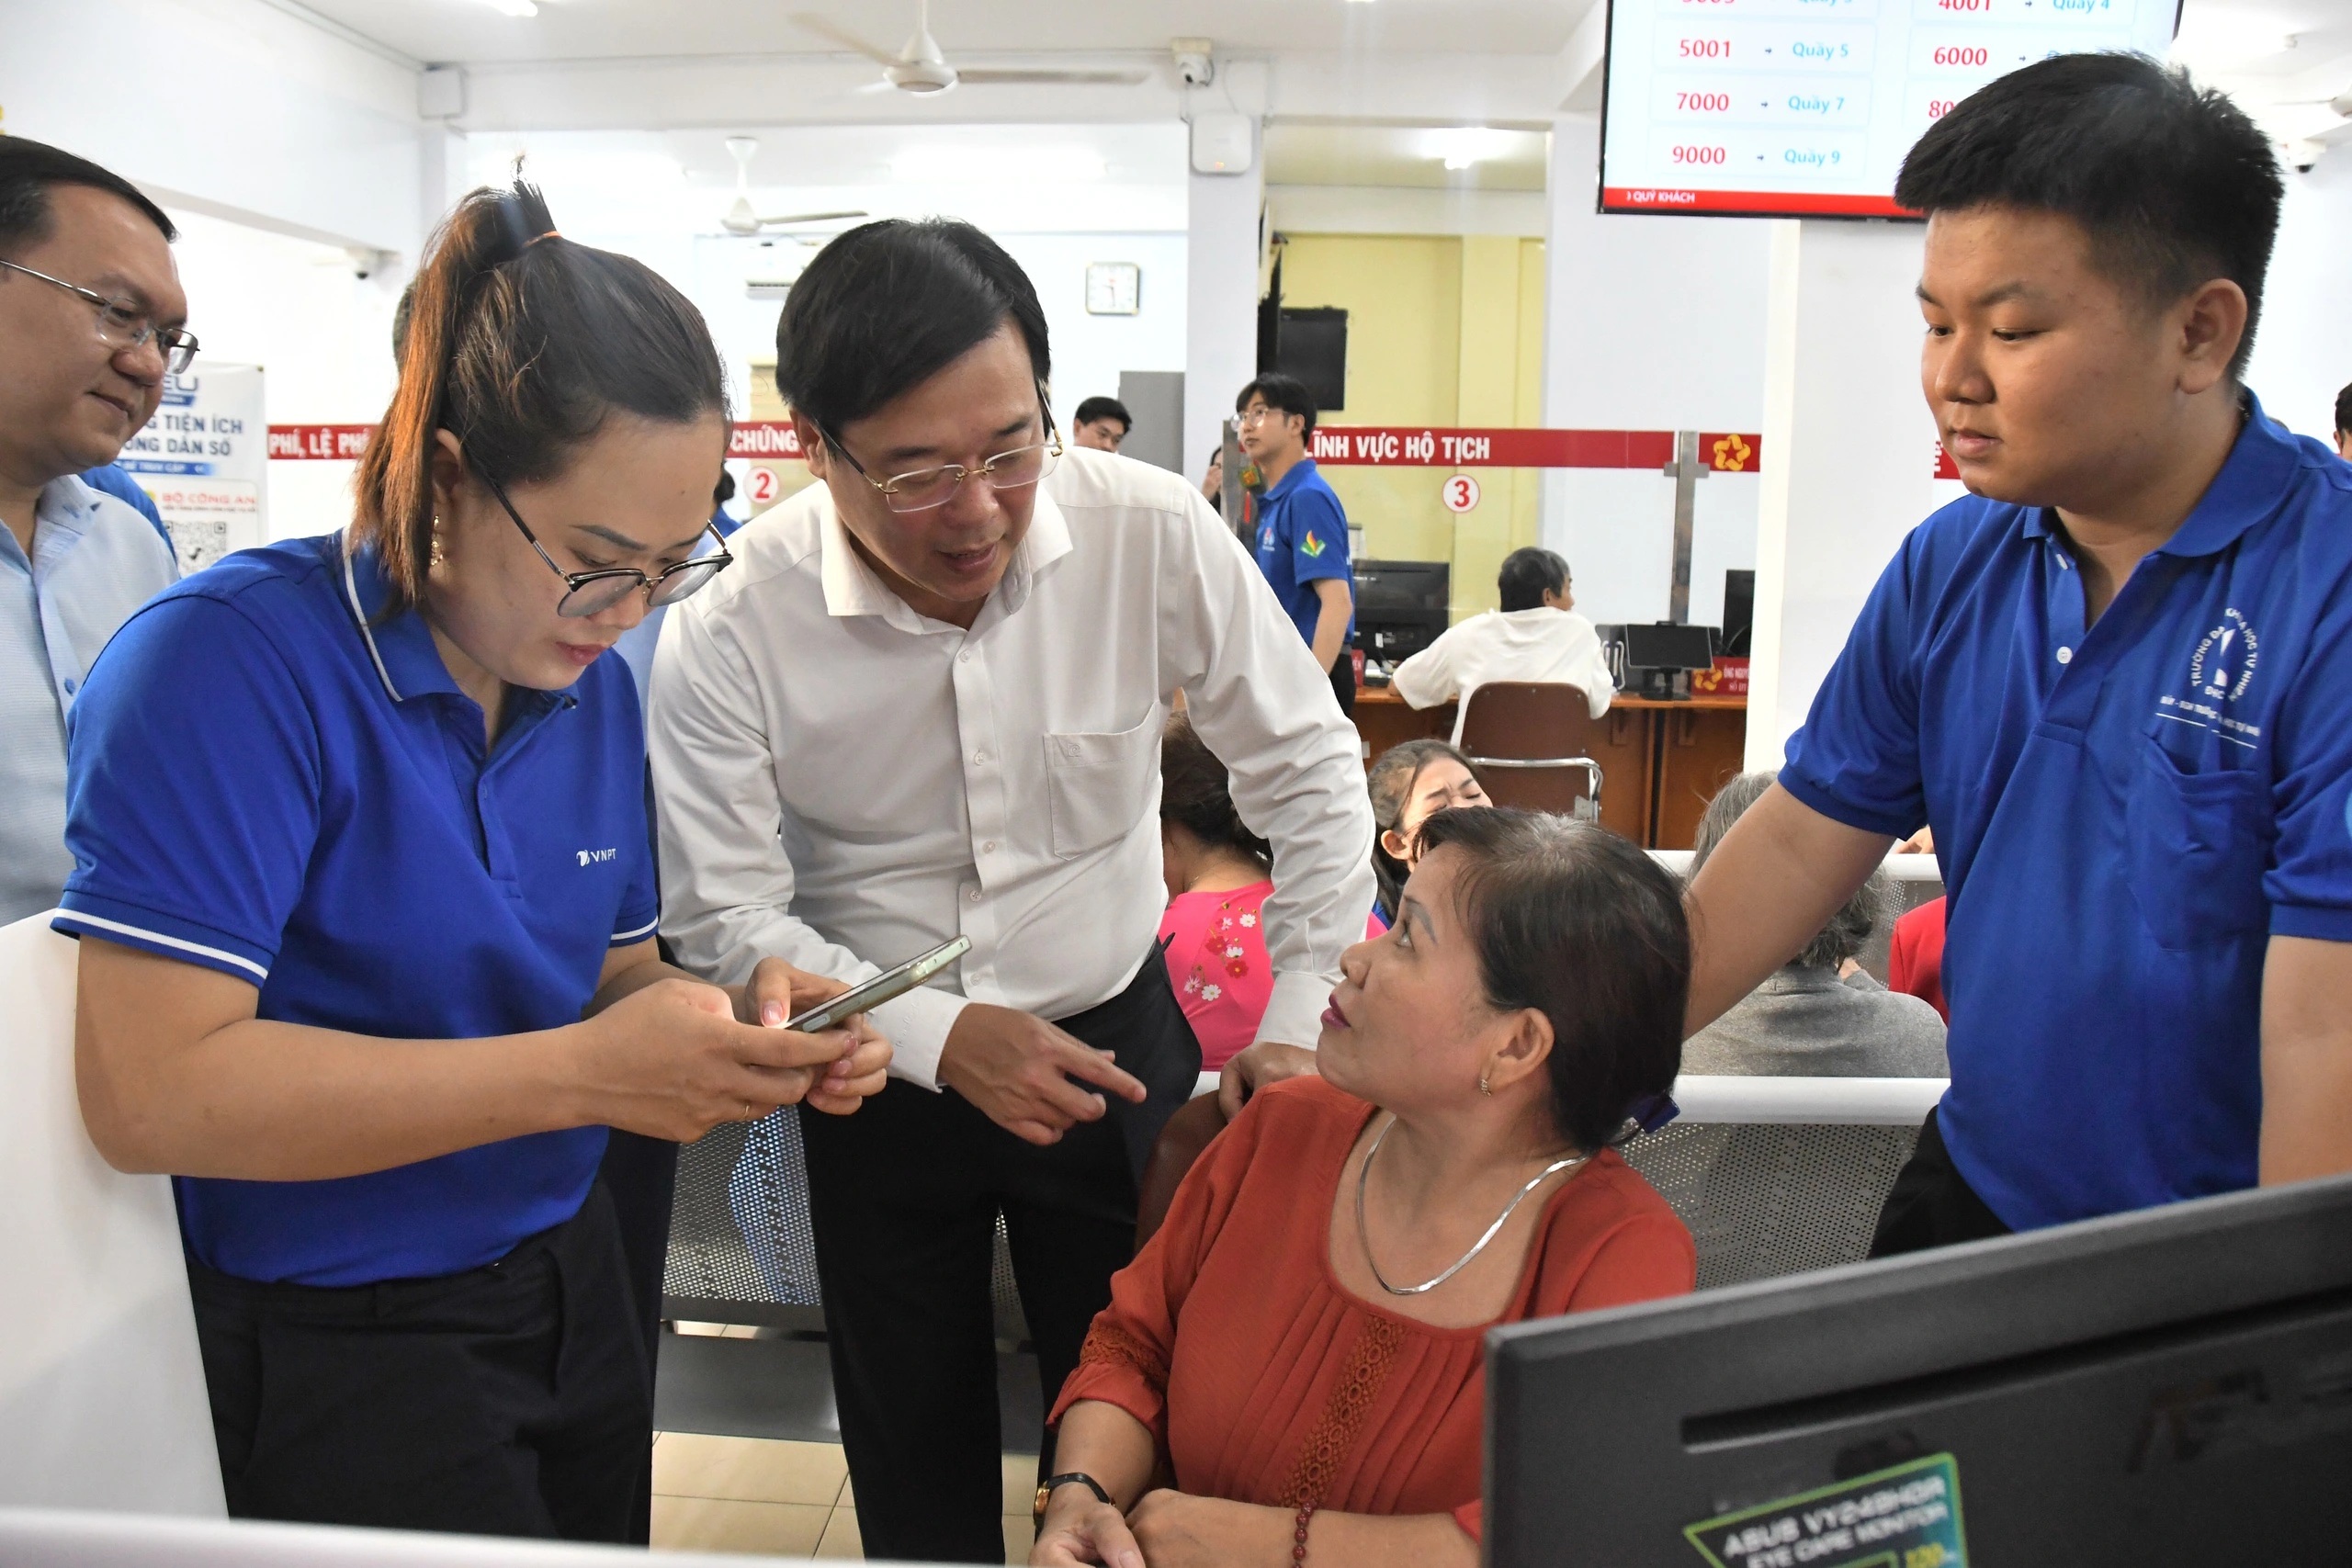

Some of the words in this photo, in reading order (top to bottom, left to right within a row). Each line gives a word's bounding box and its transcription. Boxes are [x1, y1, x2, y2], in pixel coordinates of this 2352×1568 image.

[1679, 39, 1731, 58] 5001
[1840, 43, 1849, 58] 5
[1934, 47, 1987, 66] 6000
[1676, 93, 1730, 111] 7000
[1836, 97, 1845, 111] 7
[1928, 100, 1954, 118] 80
[1672, 145, 1726, 164] 9000
[1831, 151, 1841, 164] 9
[309, 427, 333, 458] LỆ
[730, 424, 799, 452] CHỨNG
[1355, 432, 1399, 463] VỰC
[1406, 431, 1435, 463] HỘ
[1442, 436, 1490, 464] TỊCH
[755, 472, 770, 499] 2
[1454, 479, 1470, 507] 3
[590, 848, 616, 863] VNPT
[1724, 1517, 1800, 1559] ASUS
